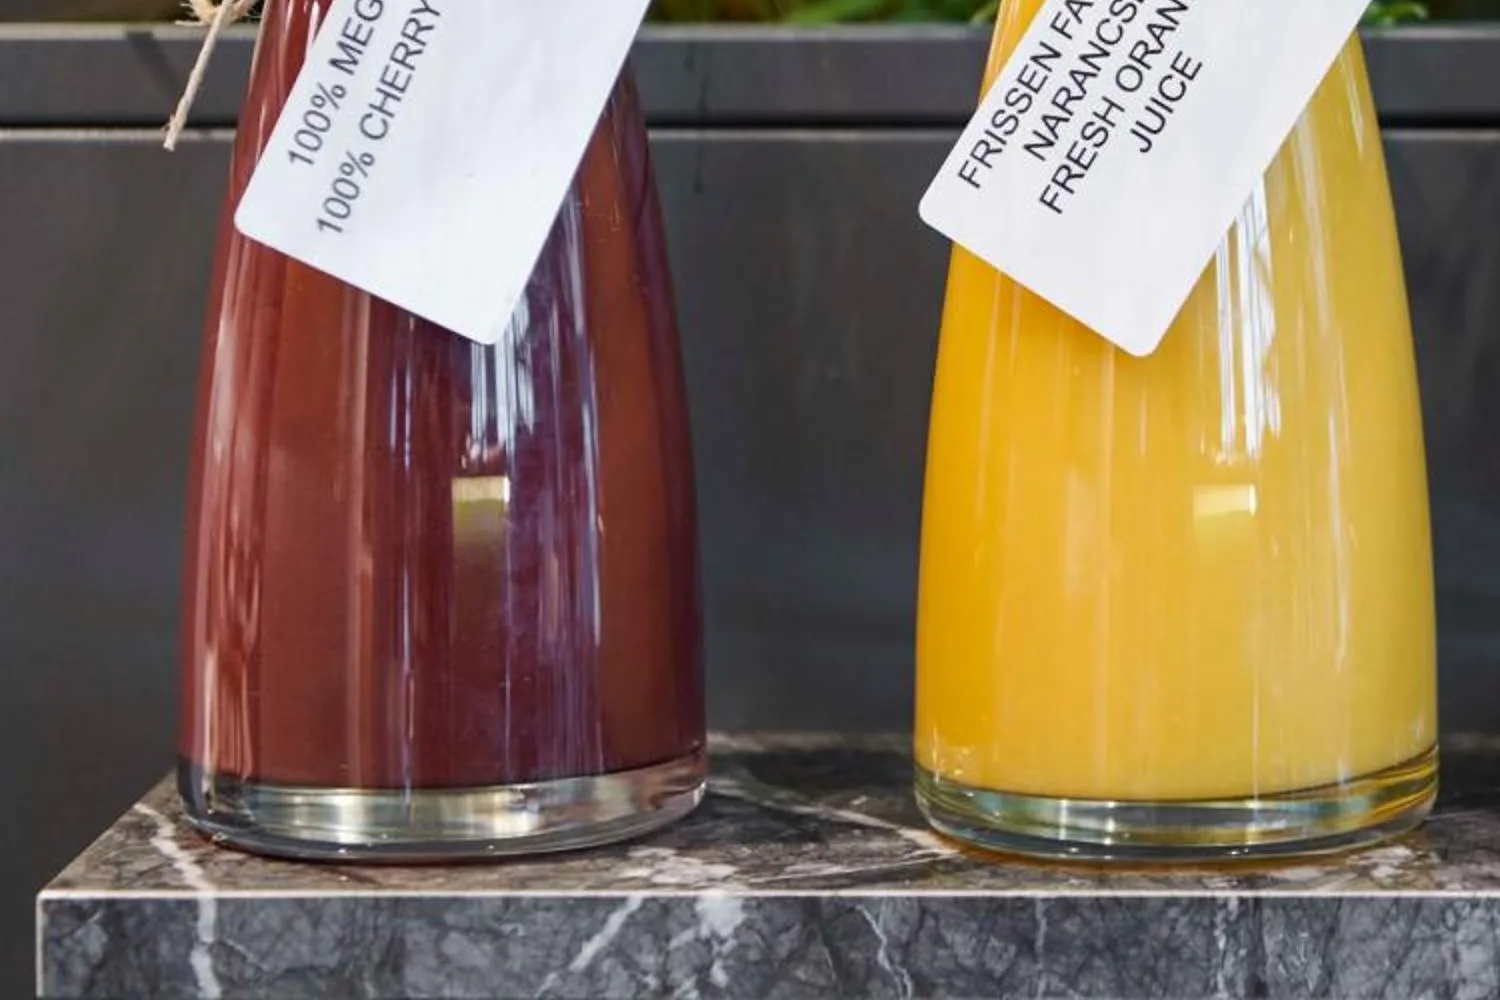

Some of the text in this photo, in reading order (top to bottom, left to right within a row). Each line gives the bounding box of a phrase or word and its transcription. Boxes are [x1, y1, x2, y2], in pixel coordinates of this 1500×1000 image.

[287, 82, 346, 165] 100%
[958, 42, 1061, 188] FRISSEN
[1130, 51, 1203, 153] JUICE
[317, 151, 374, 234] 100%
[1039, 96, 1126, 214] FRESH
